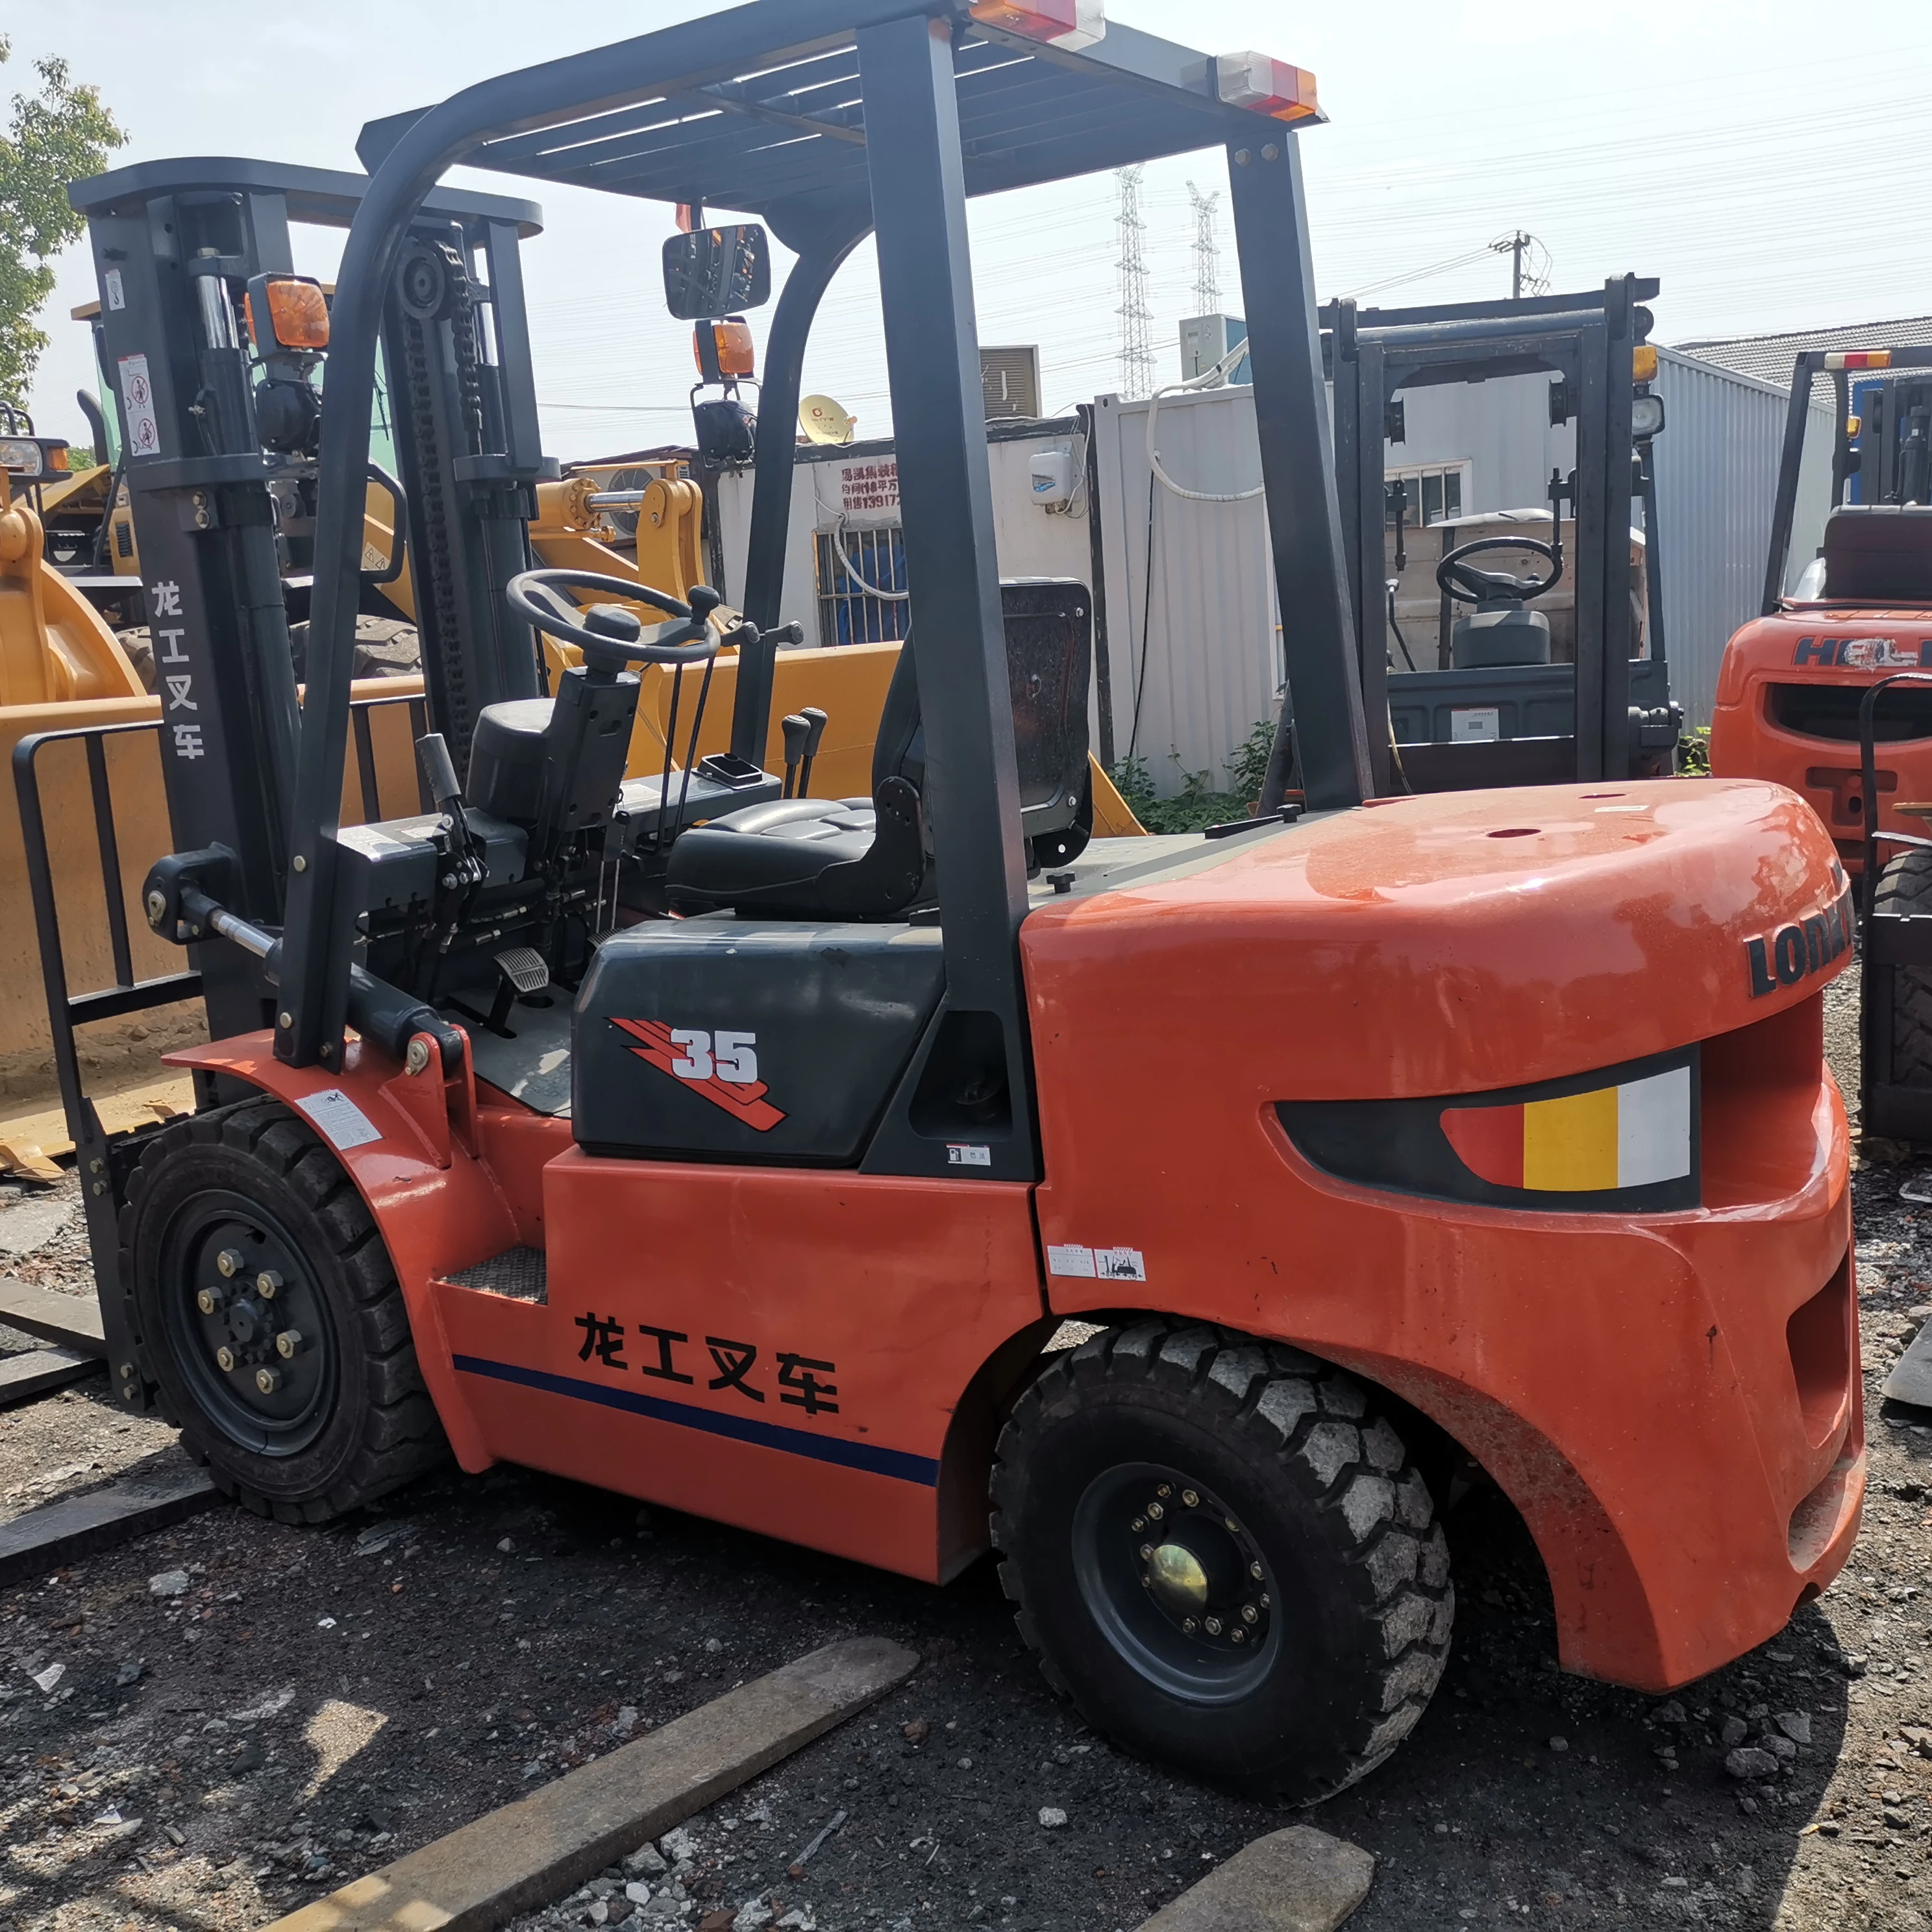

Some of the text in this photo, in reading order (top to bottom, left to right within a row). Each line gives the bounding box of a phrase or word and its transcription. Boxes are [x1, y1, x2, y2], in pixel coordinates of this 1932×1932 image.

[151, 580, 204, 760] 龙工叉车
[671, 1028, 758, 1084] 35
[574, 1311, 839, 1415] 龙工叉车
